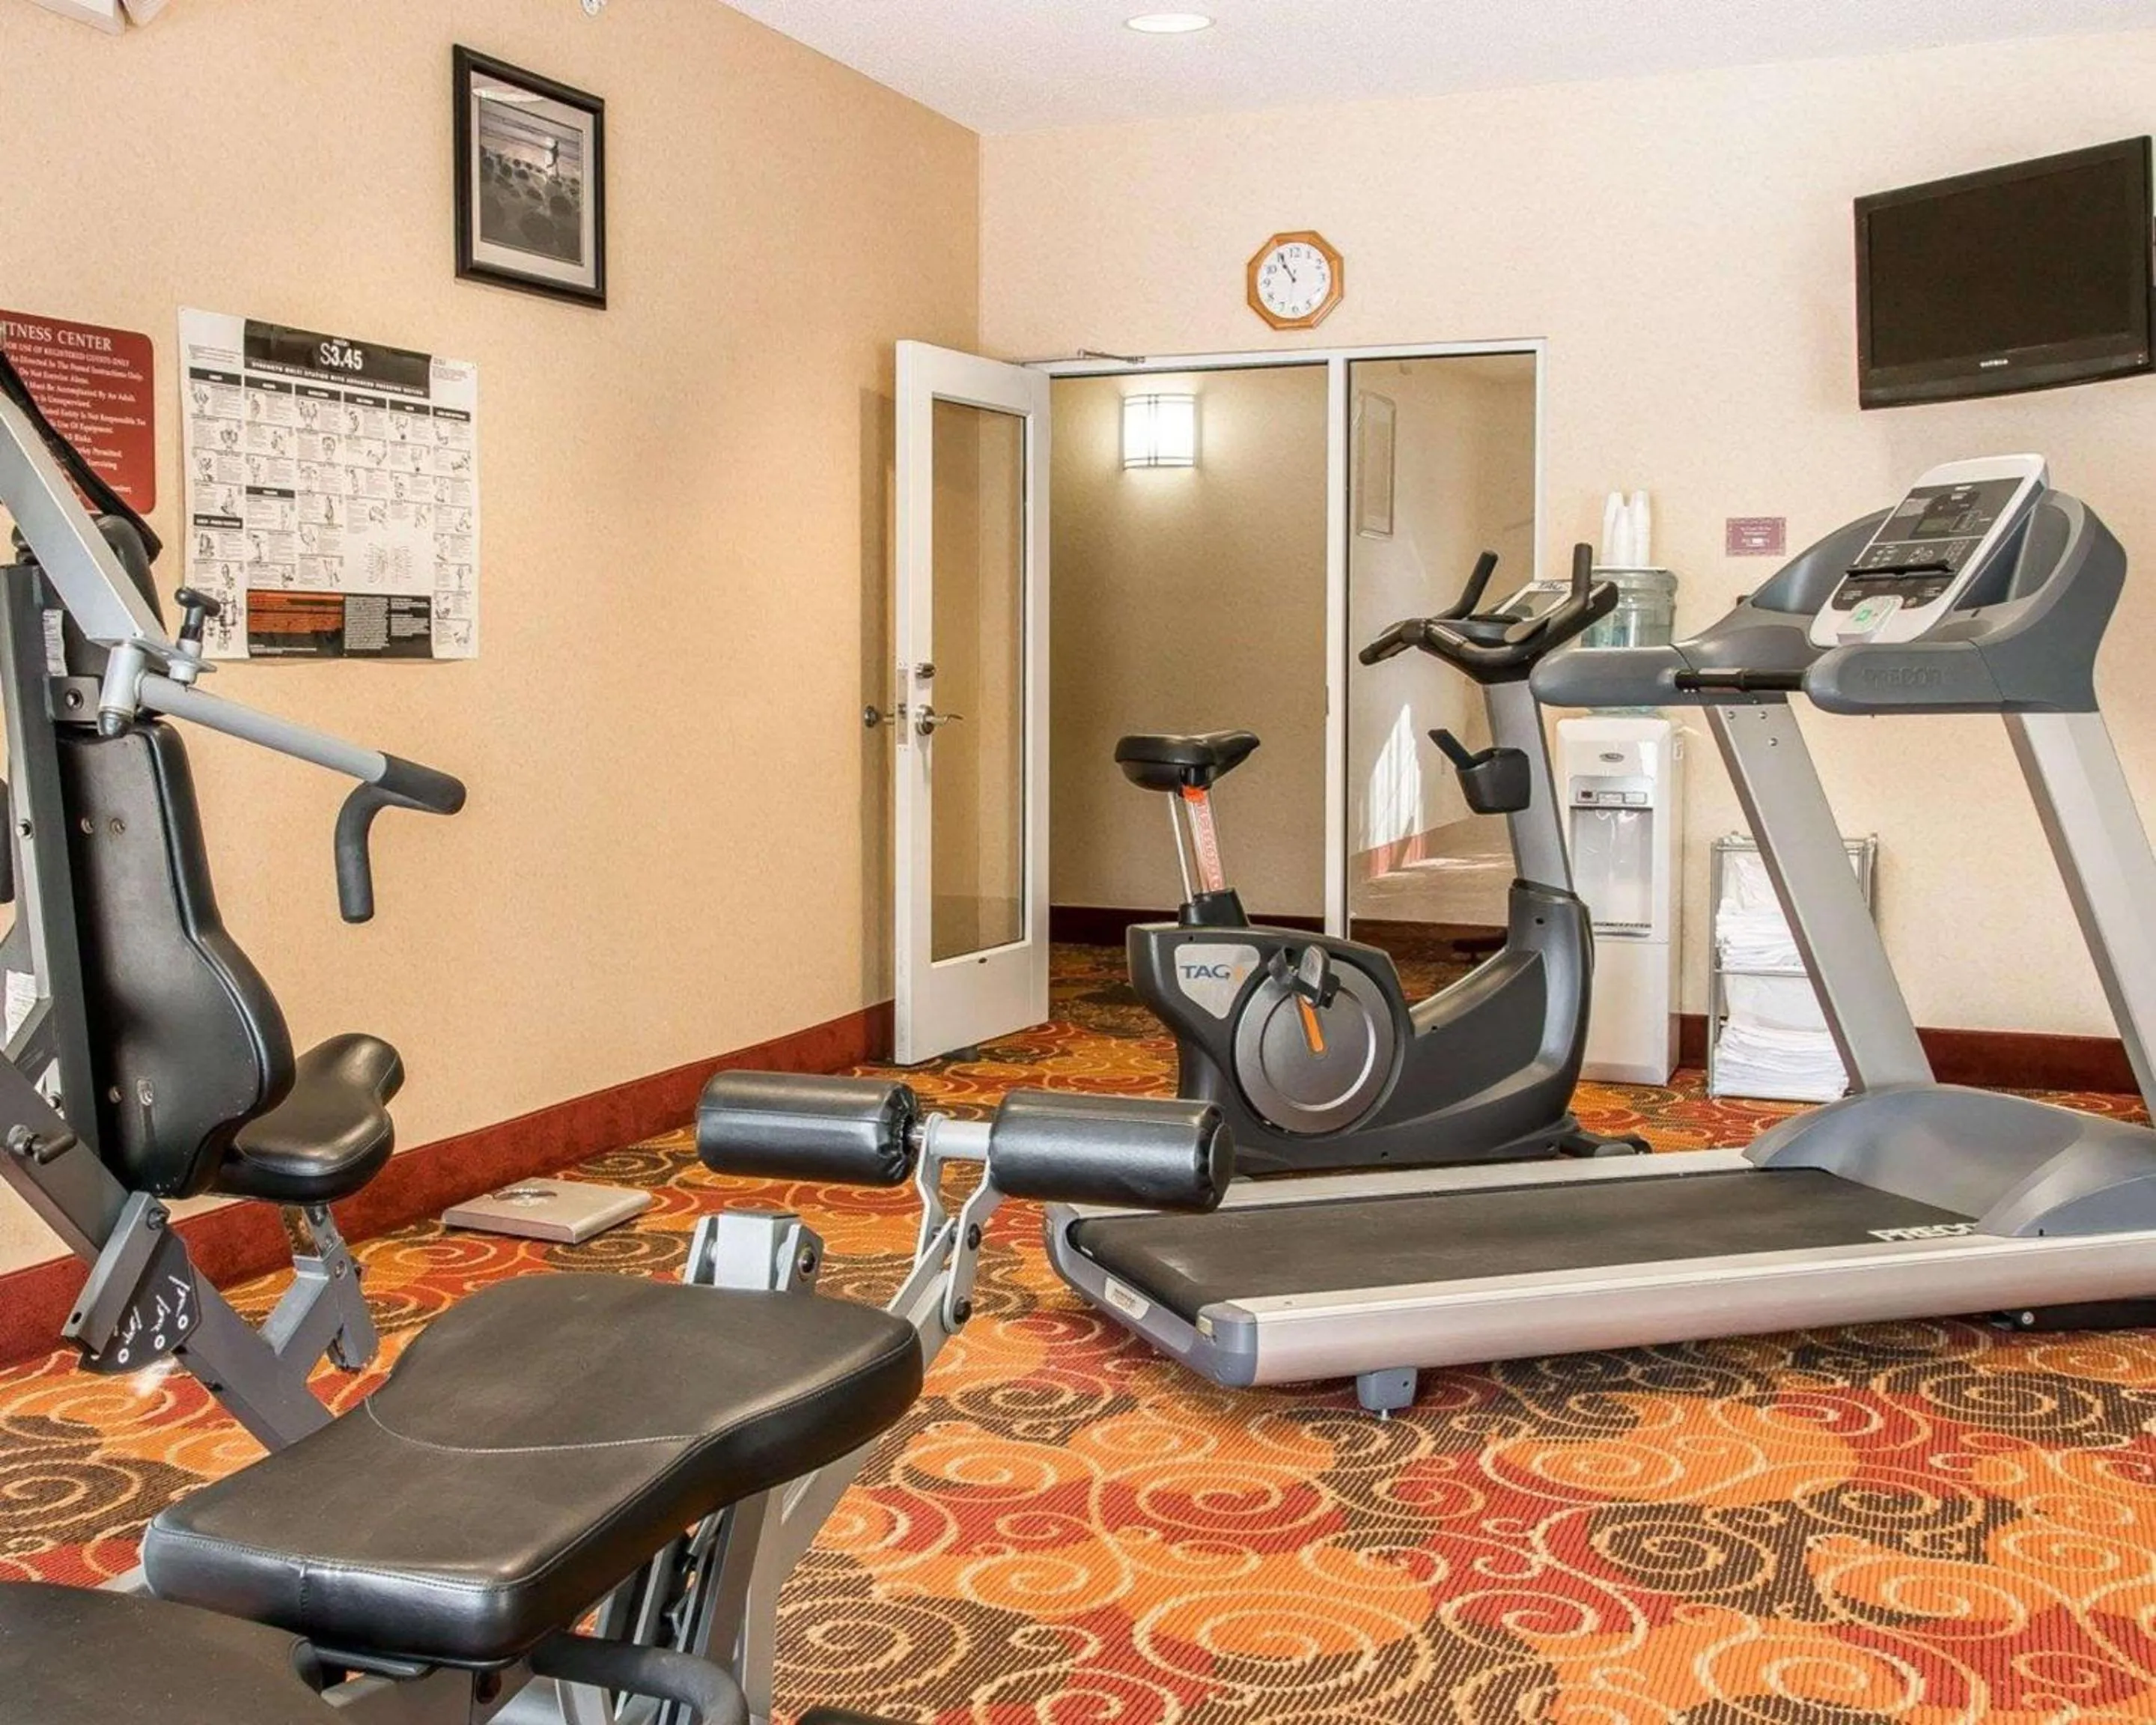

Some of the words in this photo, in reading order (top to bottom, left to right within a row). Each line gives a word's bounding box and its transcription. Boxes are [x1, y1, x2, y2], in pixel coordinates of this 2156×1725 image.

[0, 320, 52, 342] ITNESS
[57, 330, 112, 351] CENTER
[320, 342, 363, 371] S3.45
